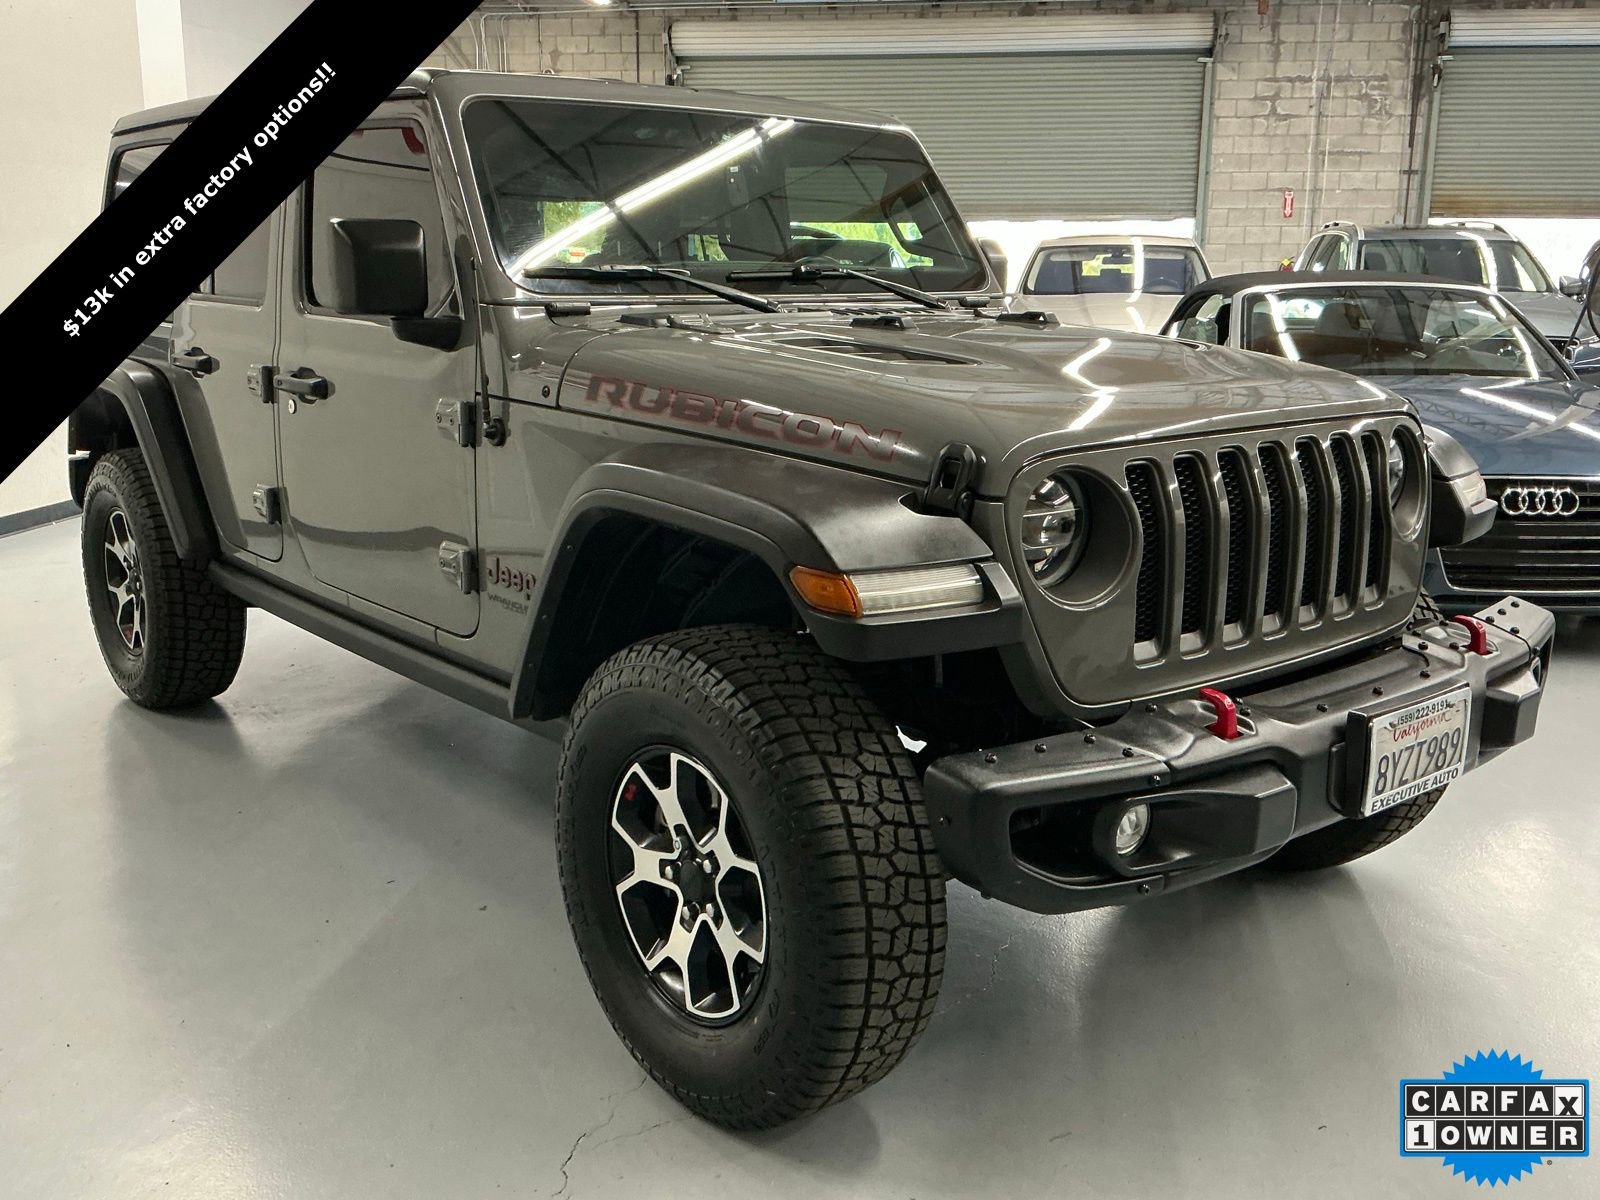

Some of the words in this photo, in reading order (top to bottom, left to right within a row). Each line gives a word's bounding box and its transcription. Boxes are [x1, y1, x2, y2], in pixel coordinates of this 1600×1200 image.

[586, 375, 902, 462] RUBICON
[487, 557, 536, 600] Jeep
[1371, 778, 1429, 813] EXECUTIVE
[1431, 767, 1459, 789] AUTO
[1375, 727, 1461, 796] 8YZT989
